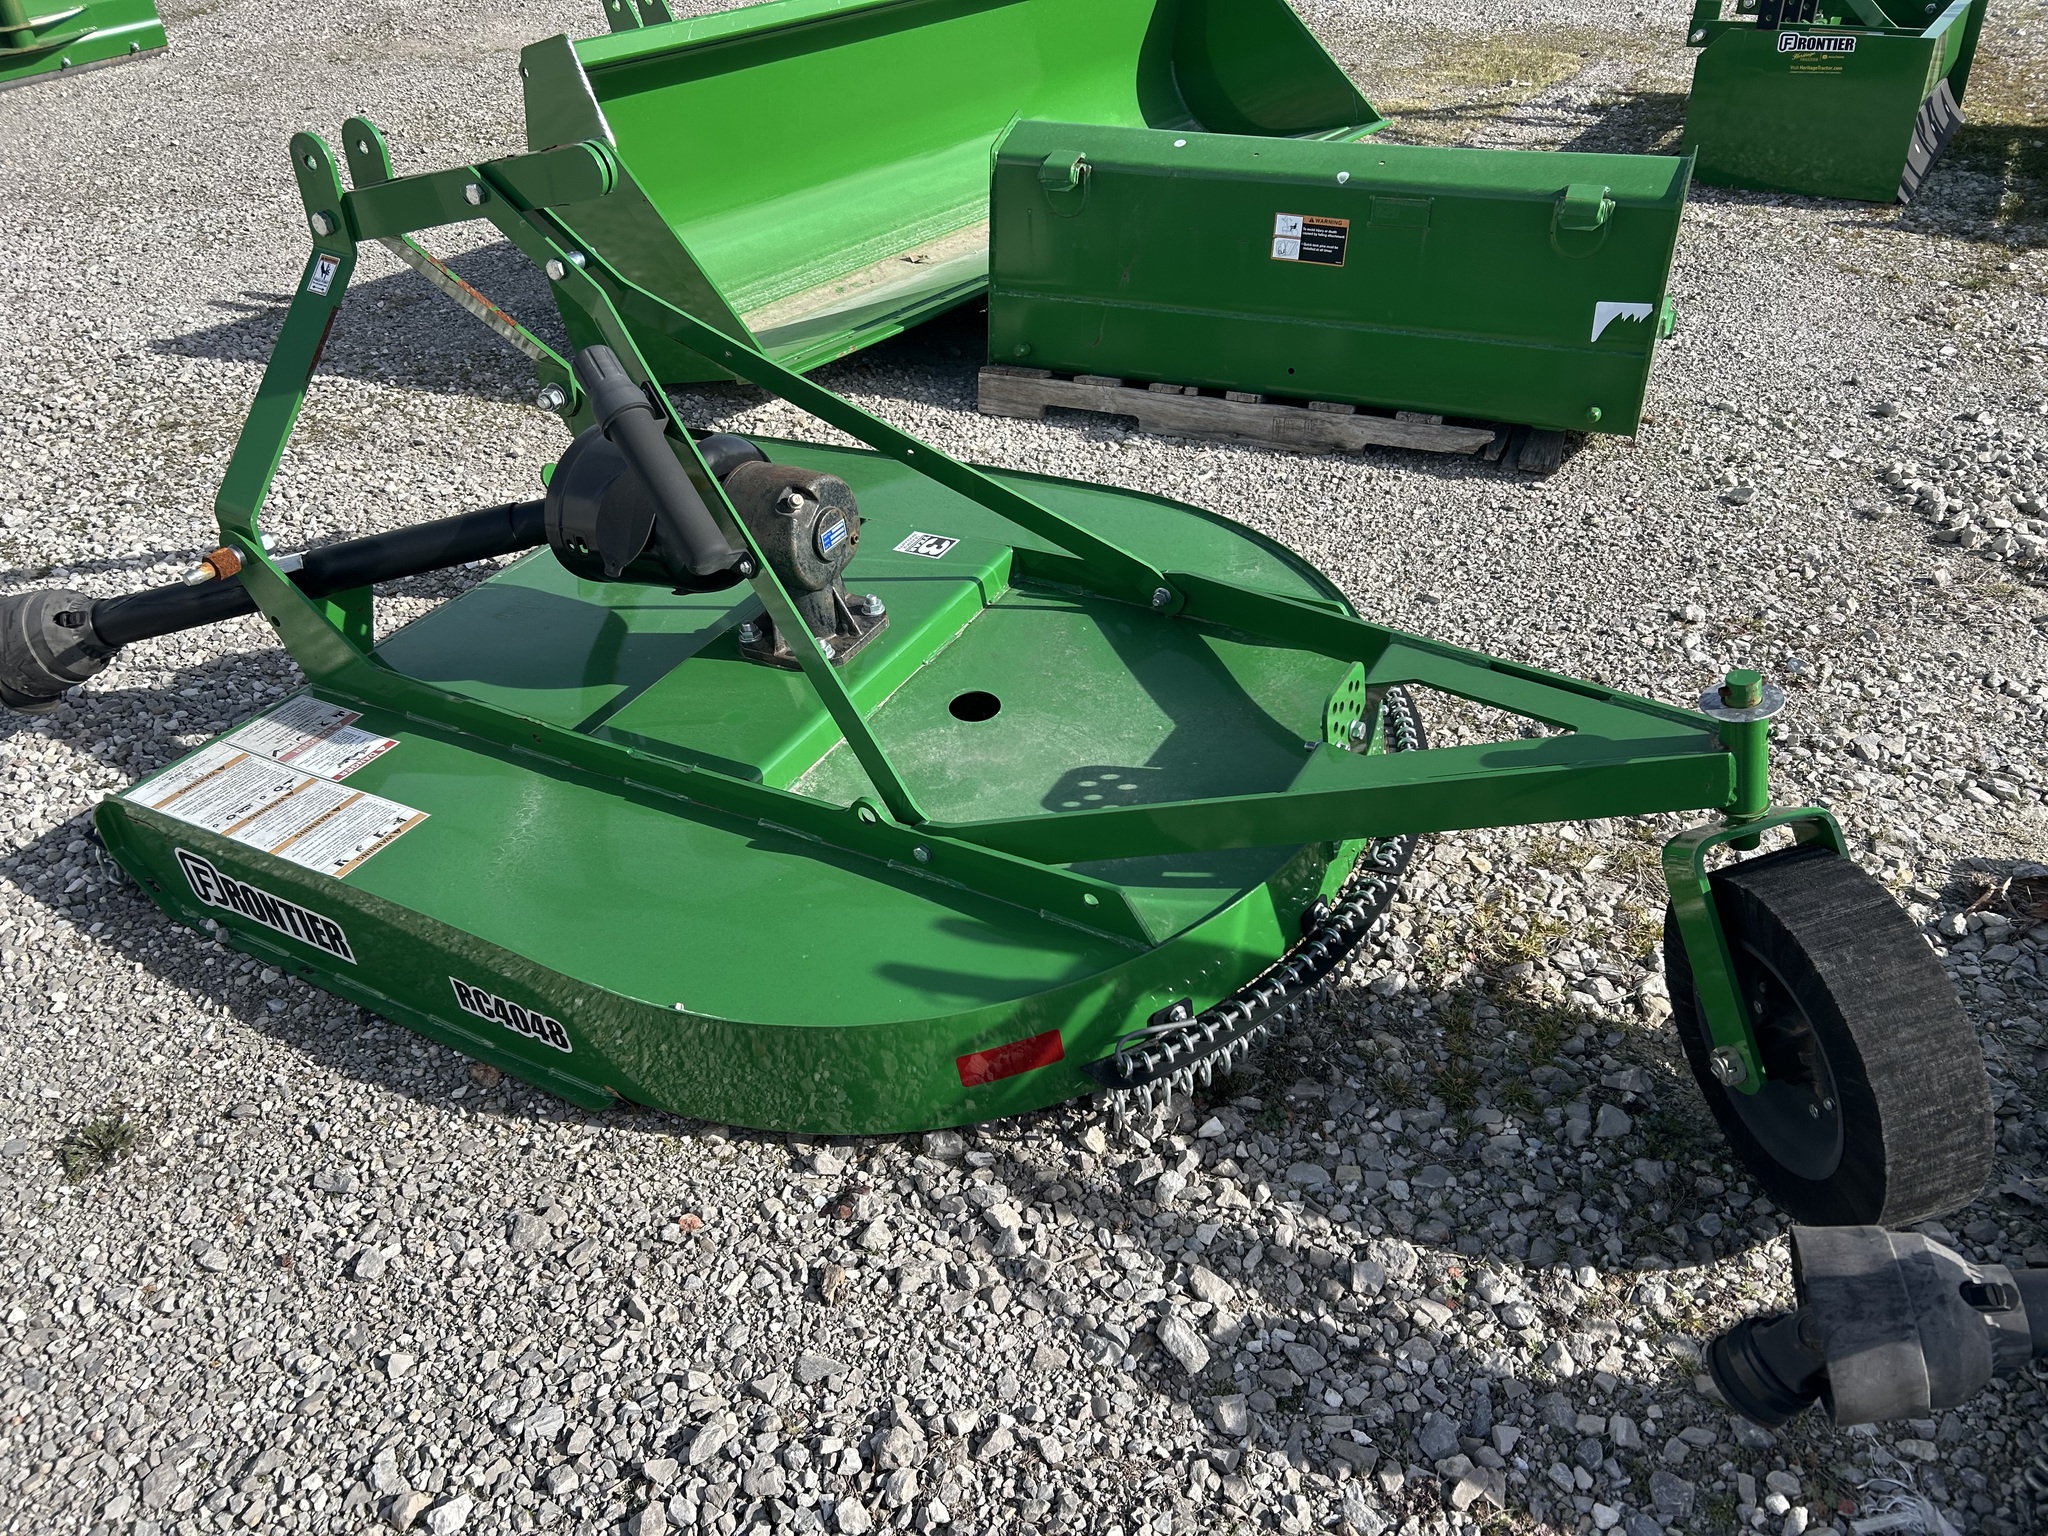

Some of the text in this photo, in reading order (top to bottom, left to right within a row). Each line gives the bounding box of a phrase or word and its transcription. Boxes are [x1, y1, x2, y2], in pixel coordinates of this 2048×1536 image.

[1778, 33, 1856, 52] FRONTIER
[908, 536, 929, 552] YEAR
[916, 538, 951, 556] 3
[289, 728, 336, 753] DANGER
[337, 752, 381, 778] DANGER
[176, 771, 218, 794] WARNING
[245, 796, 287, 821] WARNING
[292, 812, 334, 838] WARNING
[353, 834, 396, 862] WARNING
[176, 848, 355, 962] FRONTIER
[451, 978, 570, 1051] RC4048
